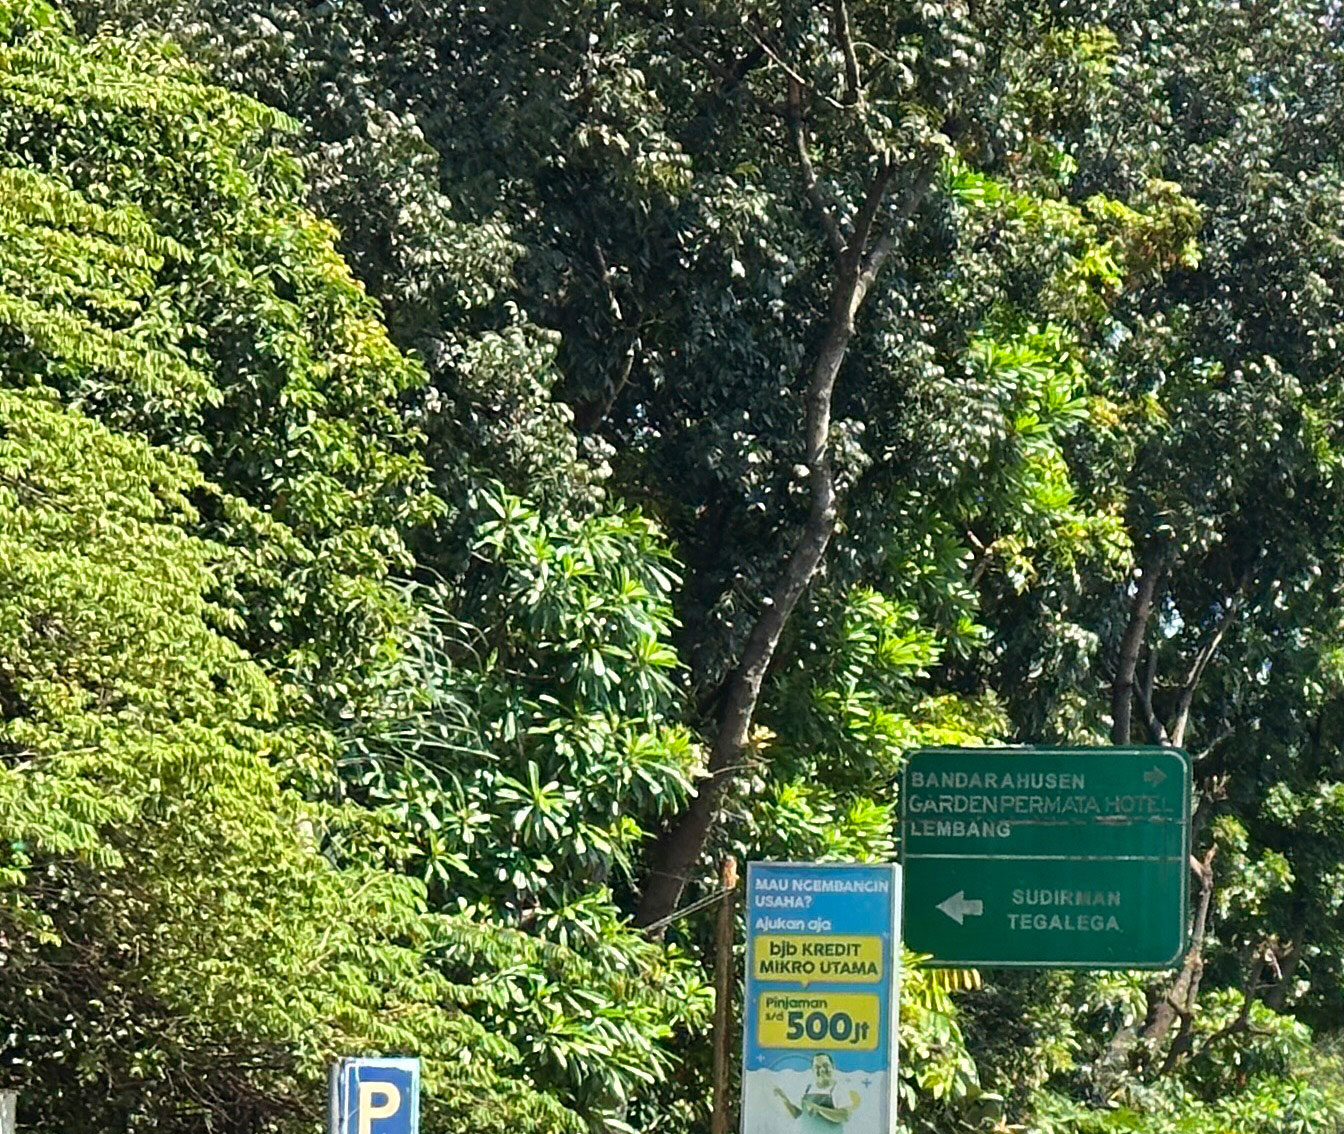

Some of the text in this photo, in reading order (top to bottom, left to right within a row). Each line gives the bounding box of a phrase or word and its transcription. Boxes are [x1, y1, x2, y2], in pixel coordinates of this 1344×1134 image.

[911, 821, 1011, 838] LEMBANG
[755, 879, 789, 891] MAU
[755, 895, 812, 908] USAHA?
[1012, 890, 1121, 907] SUDIRMAN
[755, 917, 832, 933] Ajukan aja
[769, 941, 861, 957] bjb KREDIT
[760, 960, 878, 975] MIKRO UTAMA
[765, 997, 828, 1009] Pinjaman
